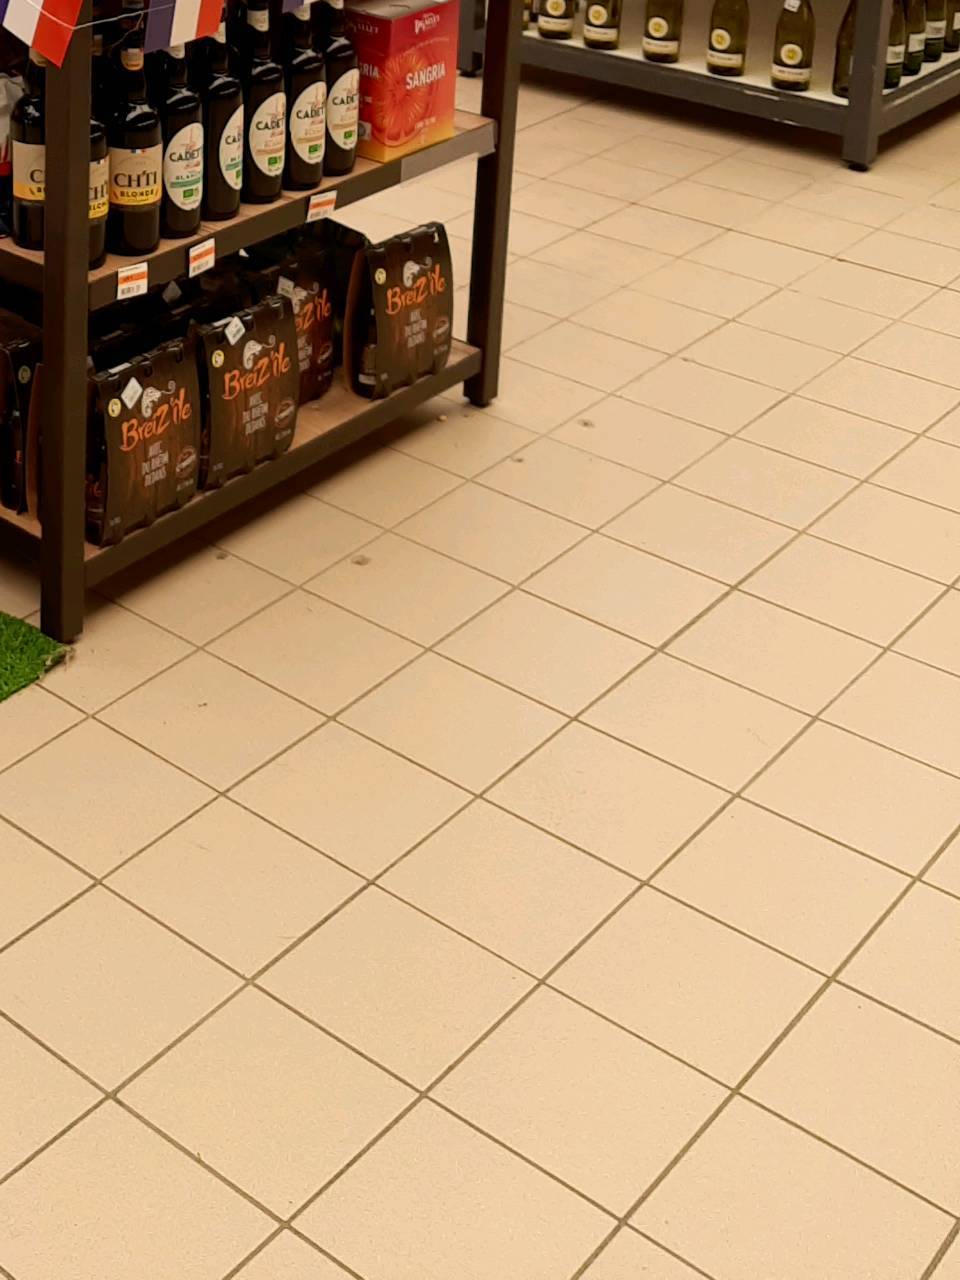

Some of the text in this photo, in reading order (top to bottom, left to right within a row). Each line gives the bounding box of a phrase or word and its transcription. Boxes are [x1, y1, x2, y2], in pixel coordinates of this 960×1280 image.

[406, 62, 446, 90] SANGRIA
[113, 169, 158, 189] CH'TI
[119, 189, 155, 199] BLONDE
